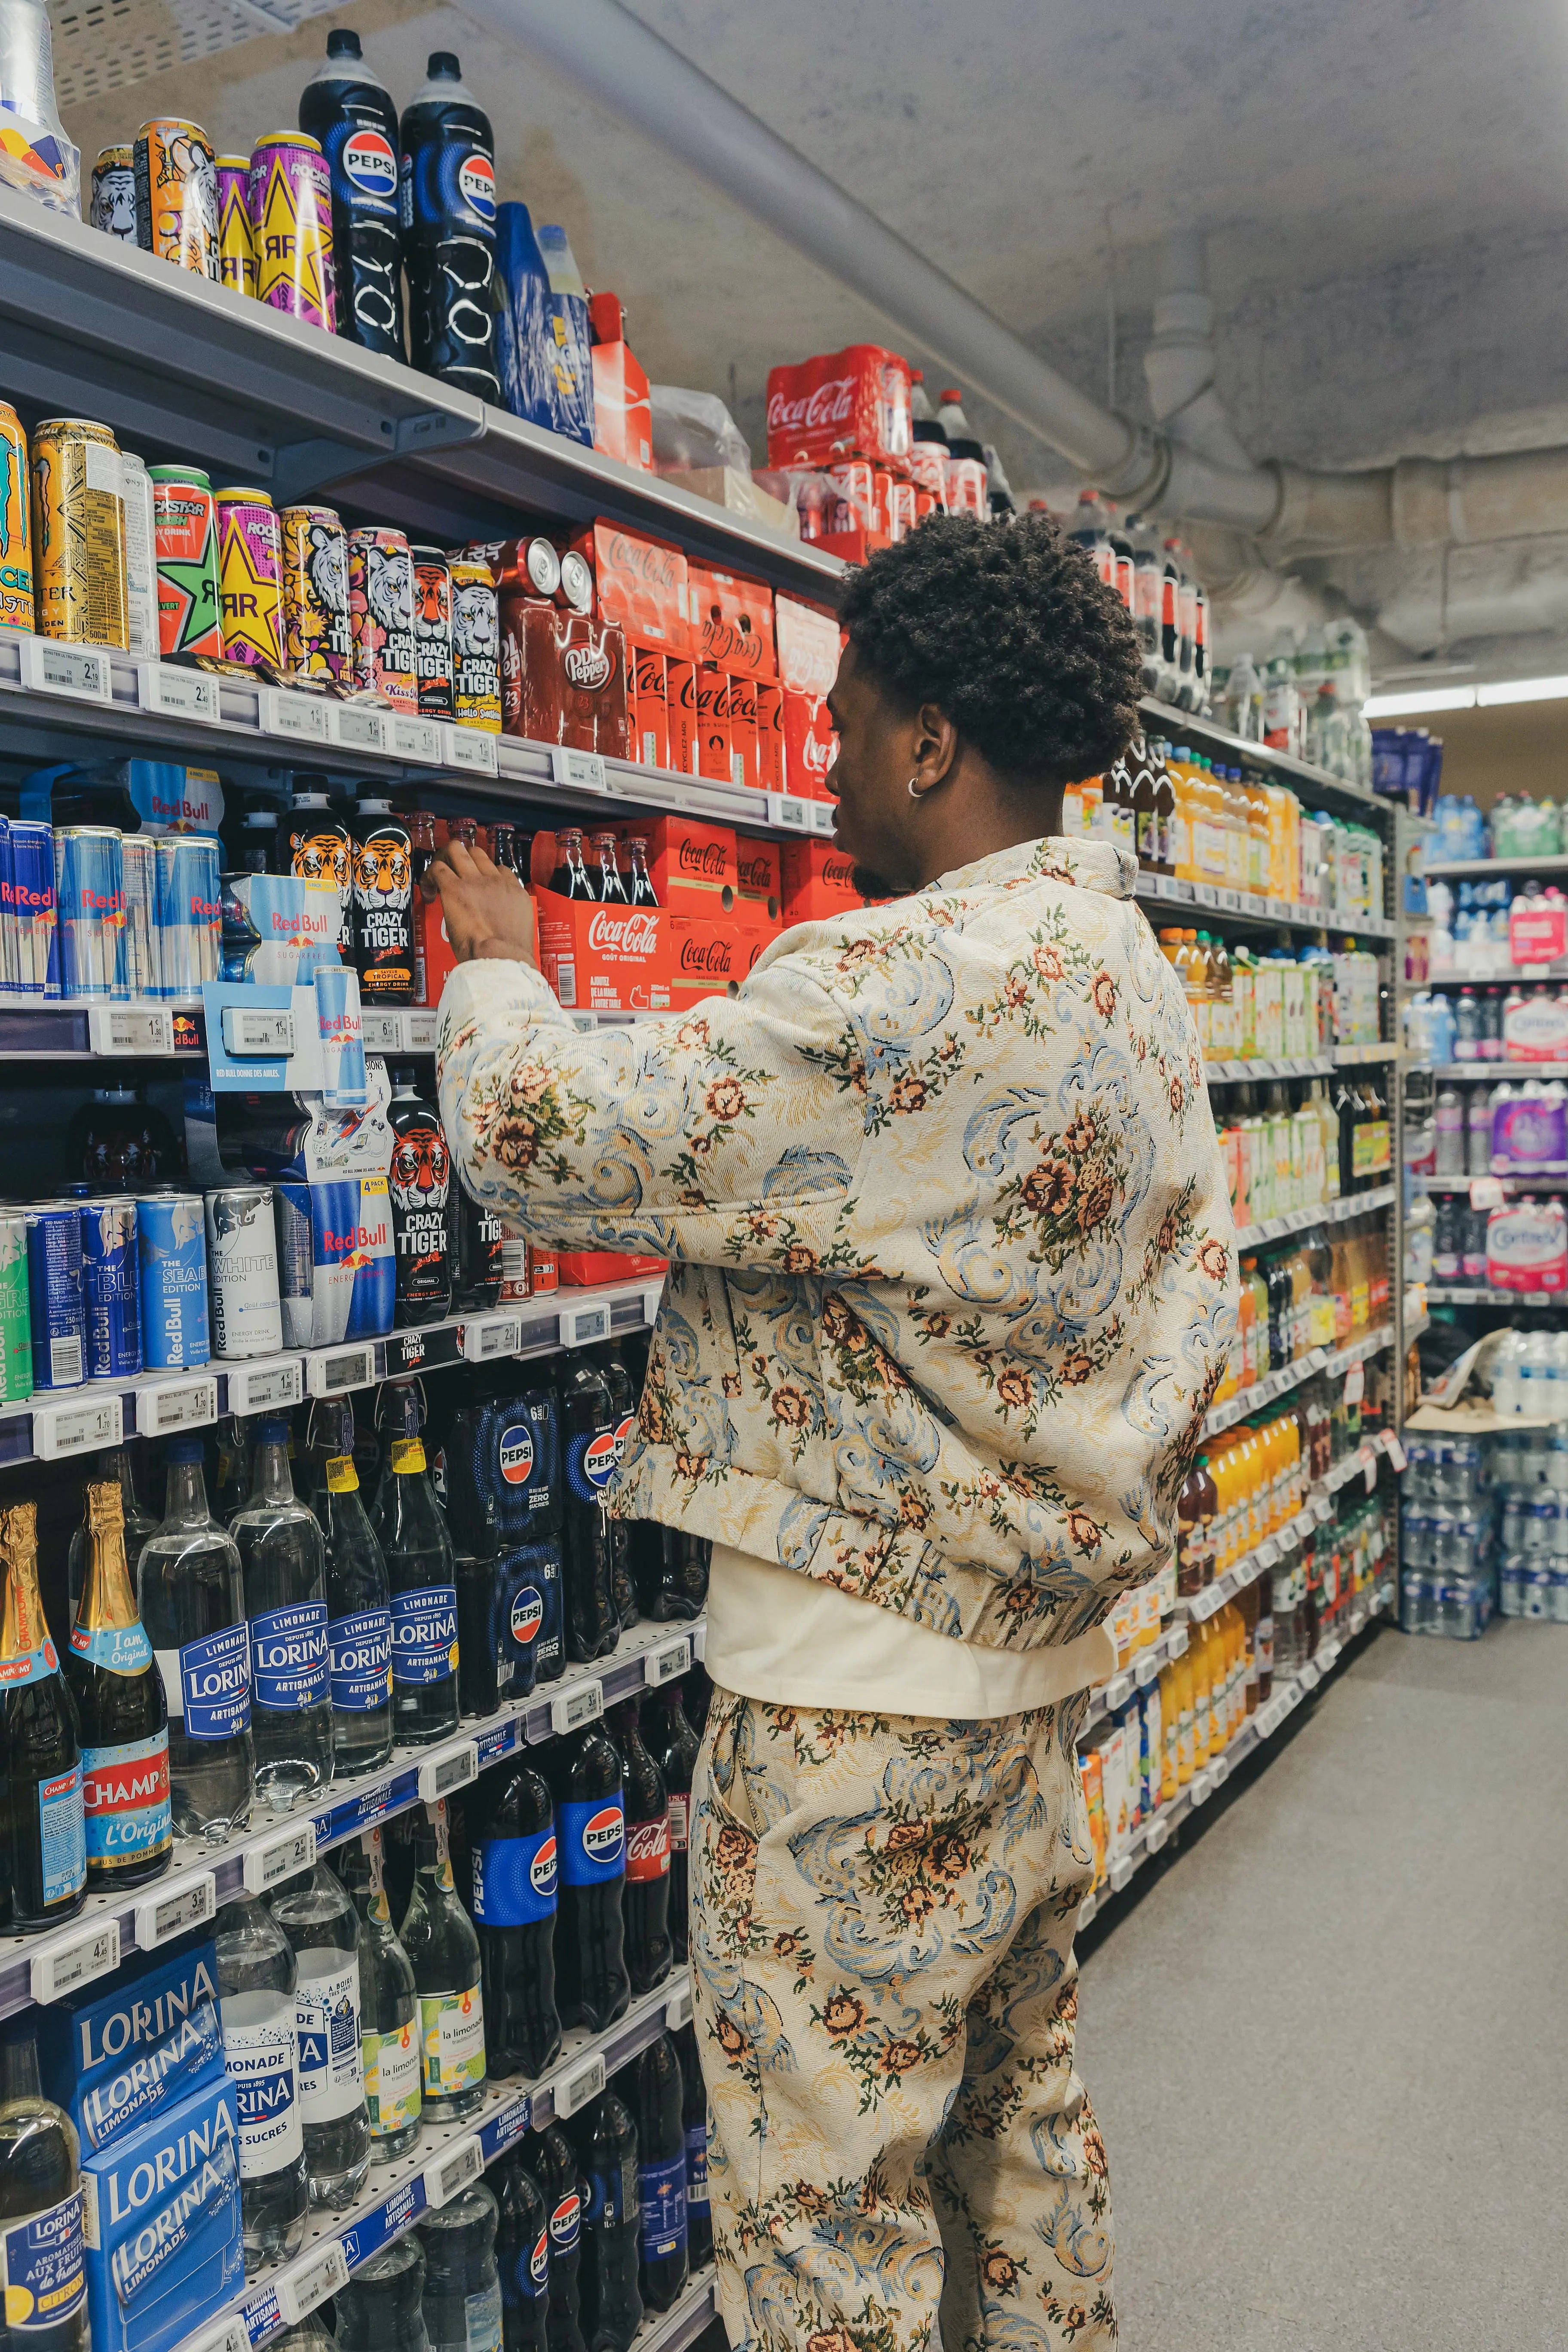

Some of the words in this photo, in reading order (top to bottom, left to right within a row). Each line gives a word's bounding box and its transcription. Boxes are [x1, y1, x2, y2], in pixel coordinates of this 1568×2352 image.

[348, 154, 394, 177] PEPSI
[164, 528, 191, 537] DRINK
[90, 630, 108, 640] 500ml
[462, 658, 497, 677] CRAZY
[386, 684, 410, 697] Kiss
[456, 674, 500, 697] TIGER
[152, 795, 181, 817] Red
[182, 800, 209, 820] Bull
[679, 837, 728, 876] Coca-Cola
[14, 885, 52, 906] Red
[82, 889, 119, 908] Red
[272, 912, 300, 931] Red
[302, 914, 328, 933] Bull
[367, 911, 403, 928] CRAZY
[670, 921, 675, 930] 6
[361, 927, 408, 948] TIGER
[588, 910, 660, 954] Coca-Cola
[277, 951, 327, 960] SUGARFREE
[602, 952, 618, 961] GOÛT
[619, 955, 646, 963] ORIGINAL
[680, 938, 733, 973] Coca-Cola
[590, 976, 609, 986] AJOUTEZ
[591, 987, 597, 998] DE
[597, 987, 603, 997] LA
[603, 987, 618, 998] MAGIE
[595, 999, 609, 1008] VOTRE
[609, 998, 622, 1009] TABLE
[319, 1014, 341, 1030] Red
[343, 1015, 361, 1030] Bull
[183, 1033, 199, 1045] Bull
[216, 1069, 225, 1078] RED
[225, 1069, 236, 1078] BULL
[236, 1069, 253, 1078] DONNE
[253, 1069, 262, 1078] DES
[364, 1181, 371, 1192] 4
[405, 1212, 444, 1233] CRAZY
[323, 1226, 355, 1253] Red
[357, 1222, 386, 1247] Bull
[397, 1229, 447, 1255] TIGER
[211, 1253, 274, 1274] WHITE
[162, 1267, 198, 1284] SEA
[213, 1274, 247, 1283] EDITION
[328, 1272, 359, 1284] ENERGY
[361, 1268, 384, 1280] DRINK
[98, 1292, 136, 1302] EDITION
[163, 1283, 201, 1293] EDITION
[213, 1287, 225, 1318] Bull
[91, 1306, 110, 1340] Bull
[163, 1298, 182, 1331] Bull
[214, 1319, 227, 1352] Red
[404, 1333, 422, 1347] CRAZY
[93, 1341, 111, 1375] Red
[165, 1331, 184, 1365] Red
[401, 1344, 426, 1361] TIGER
[530, 1406, 537, 1421] 6
[501, 1446, 531, 1464] PEPSI
[529, 1493, 549, 1504] ZÉRO
[529, 1501, 549, 1510] SUCRES
[544, 1564, 551, 1580] 6
[403, 1594, 448, 1611] LIMONADE
[272, 1610, 320, 1630] LIMONADE
[413, 1614, 432, 1623] DEPUIS
[432, 1611, 442, 1620] 1895
[512, 1605, 541, 1626] PEPSI
[284, 1633, 305, 1643] DEPUIS
[305, 1629, 314, 1638] 1895
[344, 1616, 386, 1637] LIMONADE
[390, 1611, 457, 1646] LORINA
[112, 1631, 123, 1651] I
[123, 1634, 143, 1648] am
[257, 1628, 330, 1669] LORINA
[355, 1637, 373, 1647] DEPUIS
[372, 1635, 381, 1643] 1895
[536, 1642, 559, 1655] ZÉRO
[111, 1645, 148, 1666] Original
[218, 1657, 236, 1668] DEPUIS
[235, 1653, 243, 1663] 1895
[407, 1650, 449, 1667] ARTISANALE
[536, 1650, 559, 1662] SUCRES
[275, 1669, 325, 1692] ARTISANALE
[348, 1675, 388, 1695] ARTISANALE
[357, 1788, 393, 1816] ARTISANALE
[585, 1822, 623, 1846] PEPSI
[131, 1848, 157, 1862] POMME
[473, 1847, 485, 1916] PEPSI
[337, 1975, 353, 1990] BOIRE
[80, 1961, 217, 2071] LORINA
[443, 2030, 451, 2040] la
[90, 2018, 204, 2122] LORINA
[383, 2068, 391, 2077] la
[253, 2079, 265, 2088] 1895
[97, 2085, 165, 2138] LIMONADE
[498, 2100, 527, 2127] LIMONADE
[246, 2120, 288, 2145] SUCRES
[496, 2110, 529, 2140] ARTISANALE
[107, 2098, 237, 2226] LORINA
[386, 2183, 412, 2214] LIMONADE
[36, 2200, 80, 2239] LORINA
[118, 2159, 224, 2278] LORINA
[385, 2193, 416, 2230] ARTISANALE
[124, 2226, 188, 2294] LIMONADE
[26, 2262, 54, 2282] AUX
[39, 2274, 55, 2291] de
[41, 2272, 83, 2309] CITRON
